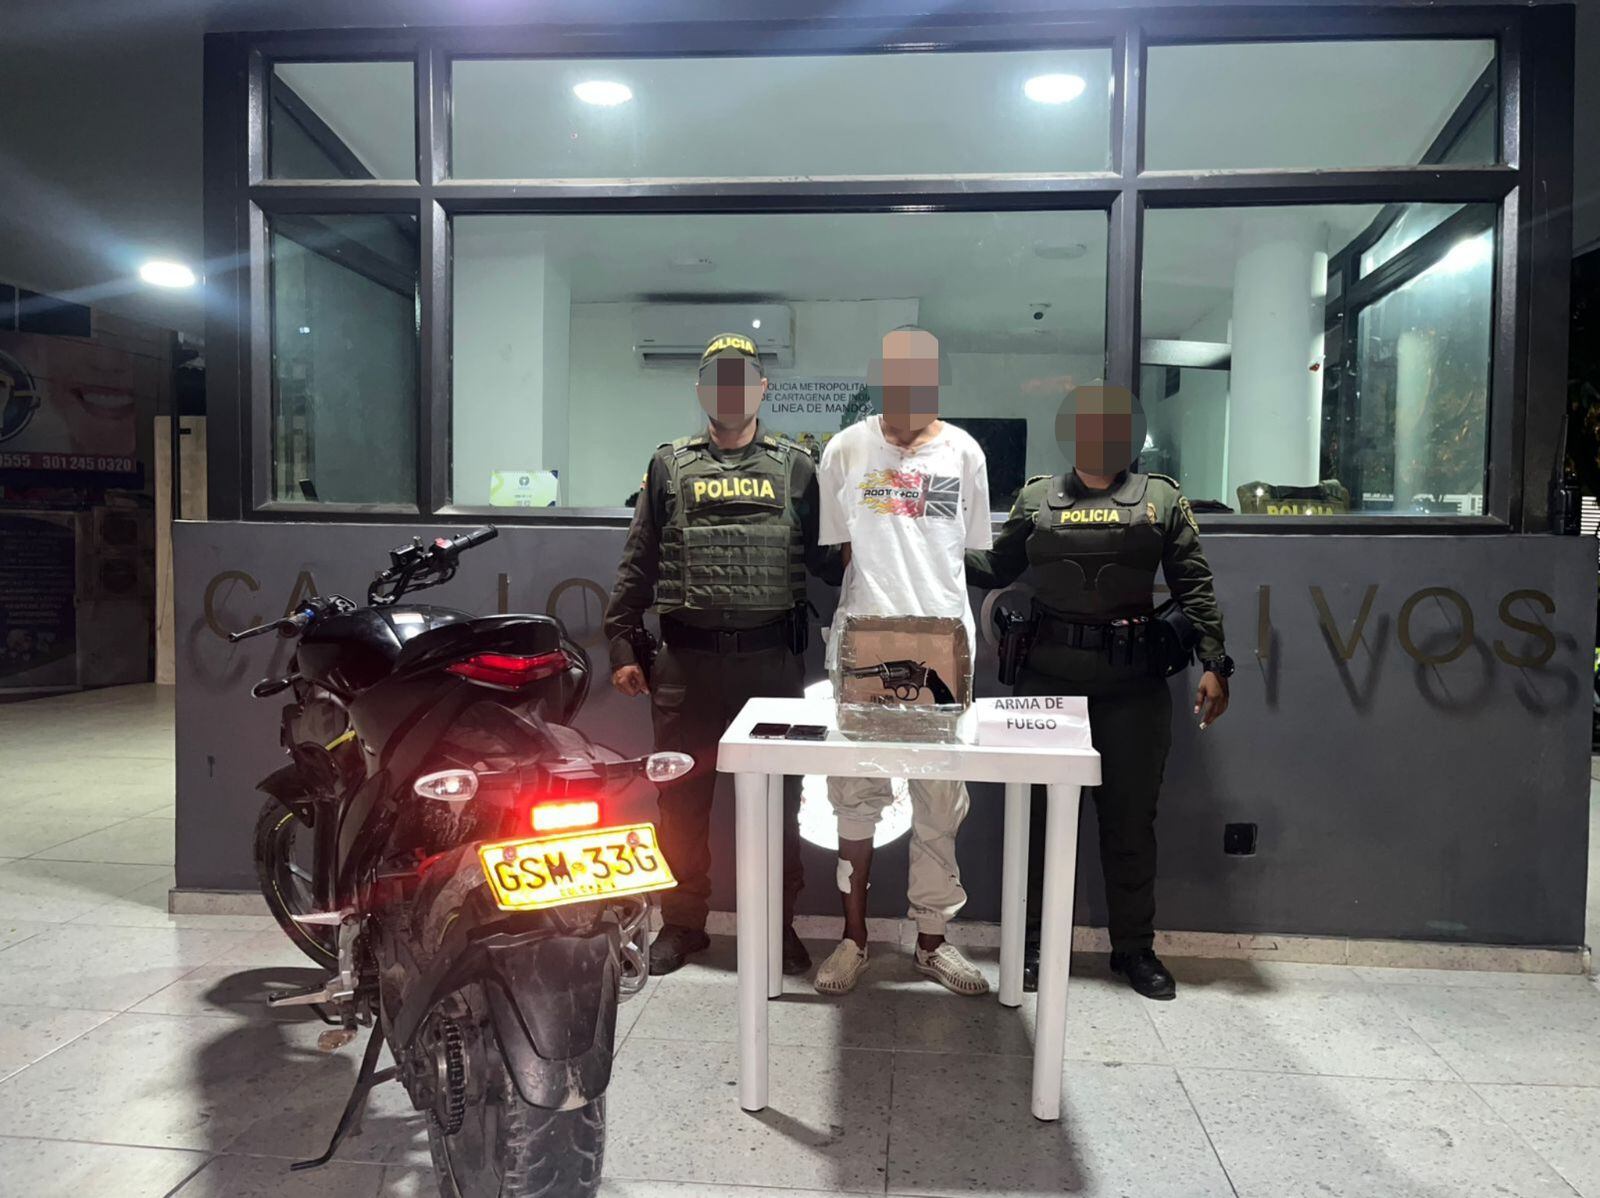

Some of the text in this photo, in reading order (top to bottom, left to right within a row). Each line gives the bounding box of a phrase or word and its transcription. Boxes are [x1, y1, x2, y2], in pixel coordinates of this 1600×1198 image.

[767, 382, 868, 391] OLICIA METROPOLITA
[774, 393, 831, 401] CARTAGENA
[833, 393, 847, 401] DE
[771, 403, 869, 413] LINEA DE MANDO
[42, 456, 66, 470] 301
[70, 456, 95, 471] 245
[98, 457, 132, 472] 0320
[693, 477, 776, 503] POLICIA
[1060, 508, 1120, 524] POLICIA
[994, 696, 1064, 710] ARMA DE
[1006, 718, 1057, 731] FUEGO
[493, 843, 659, 892] GSM 33G
